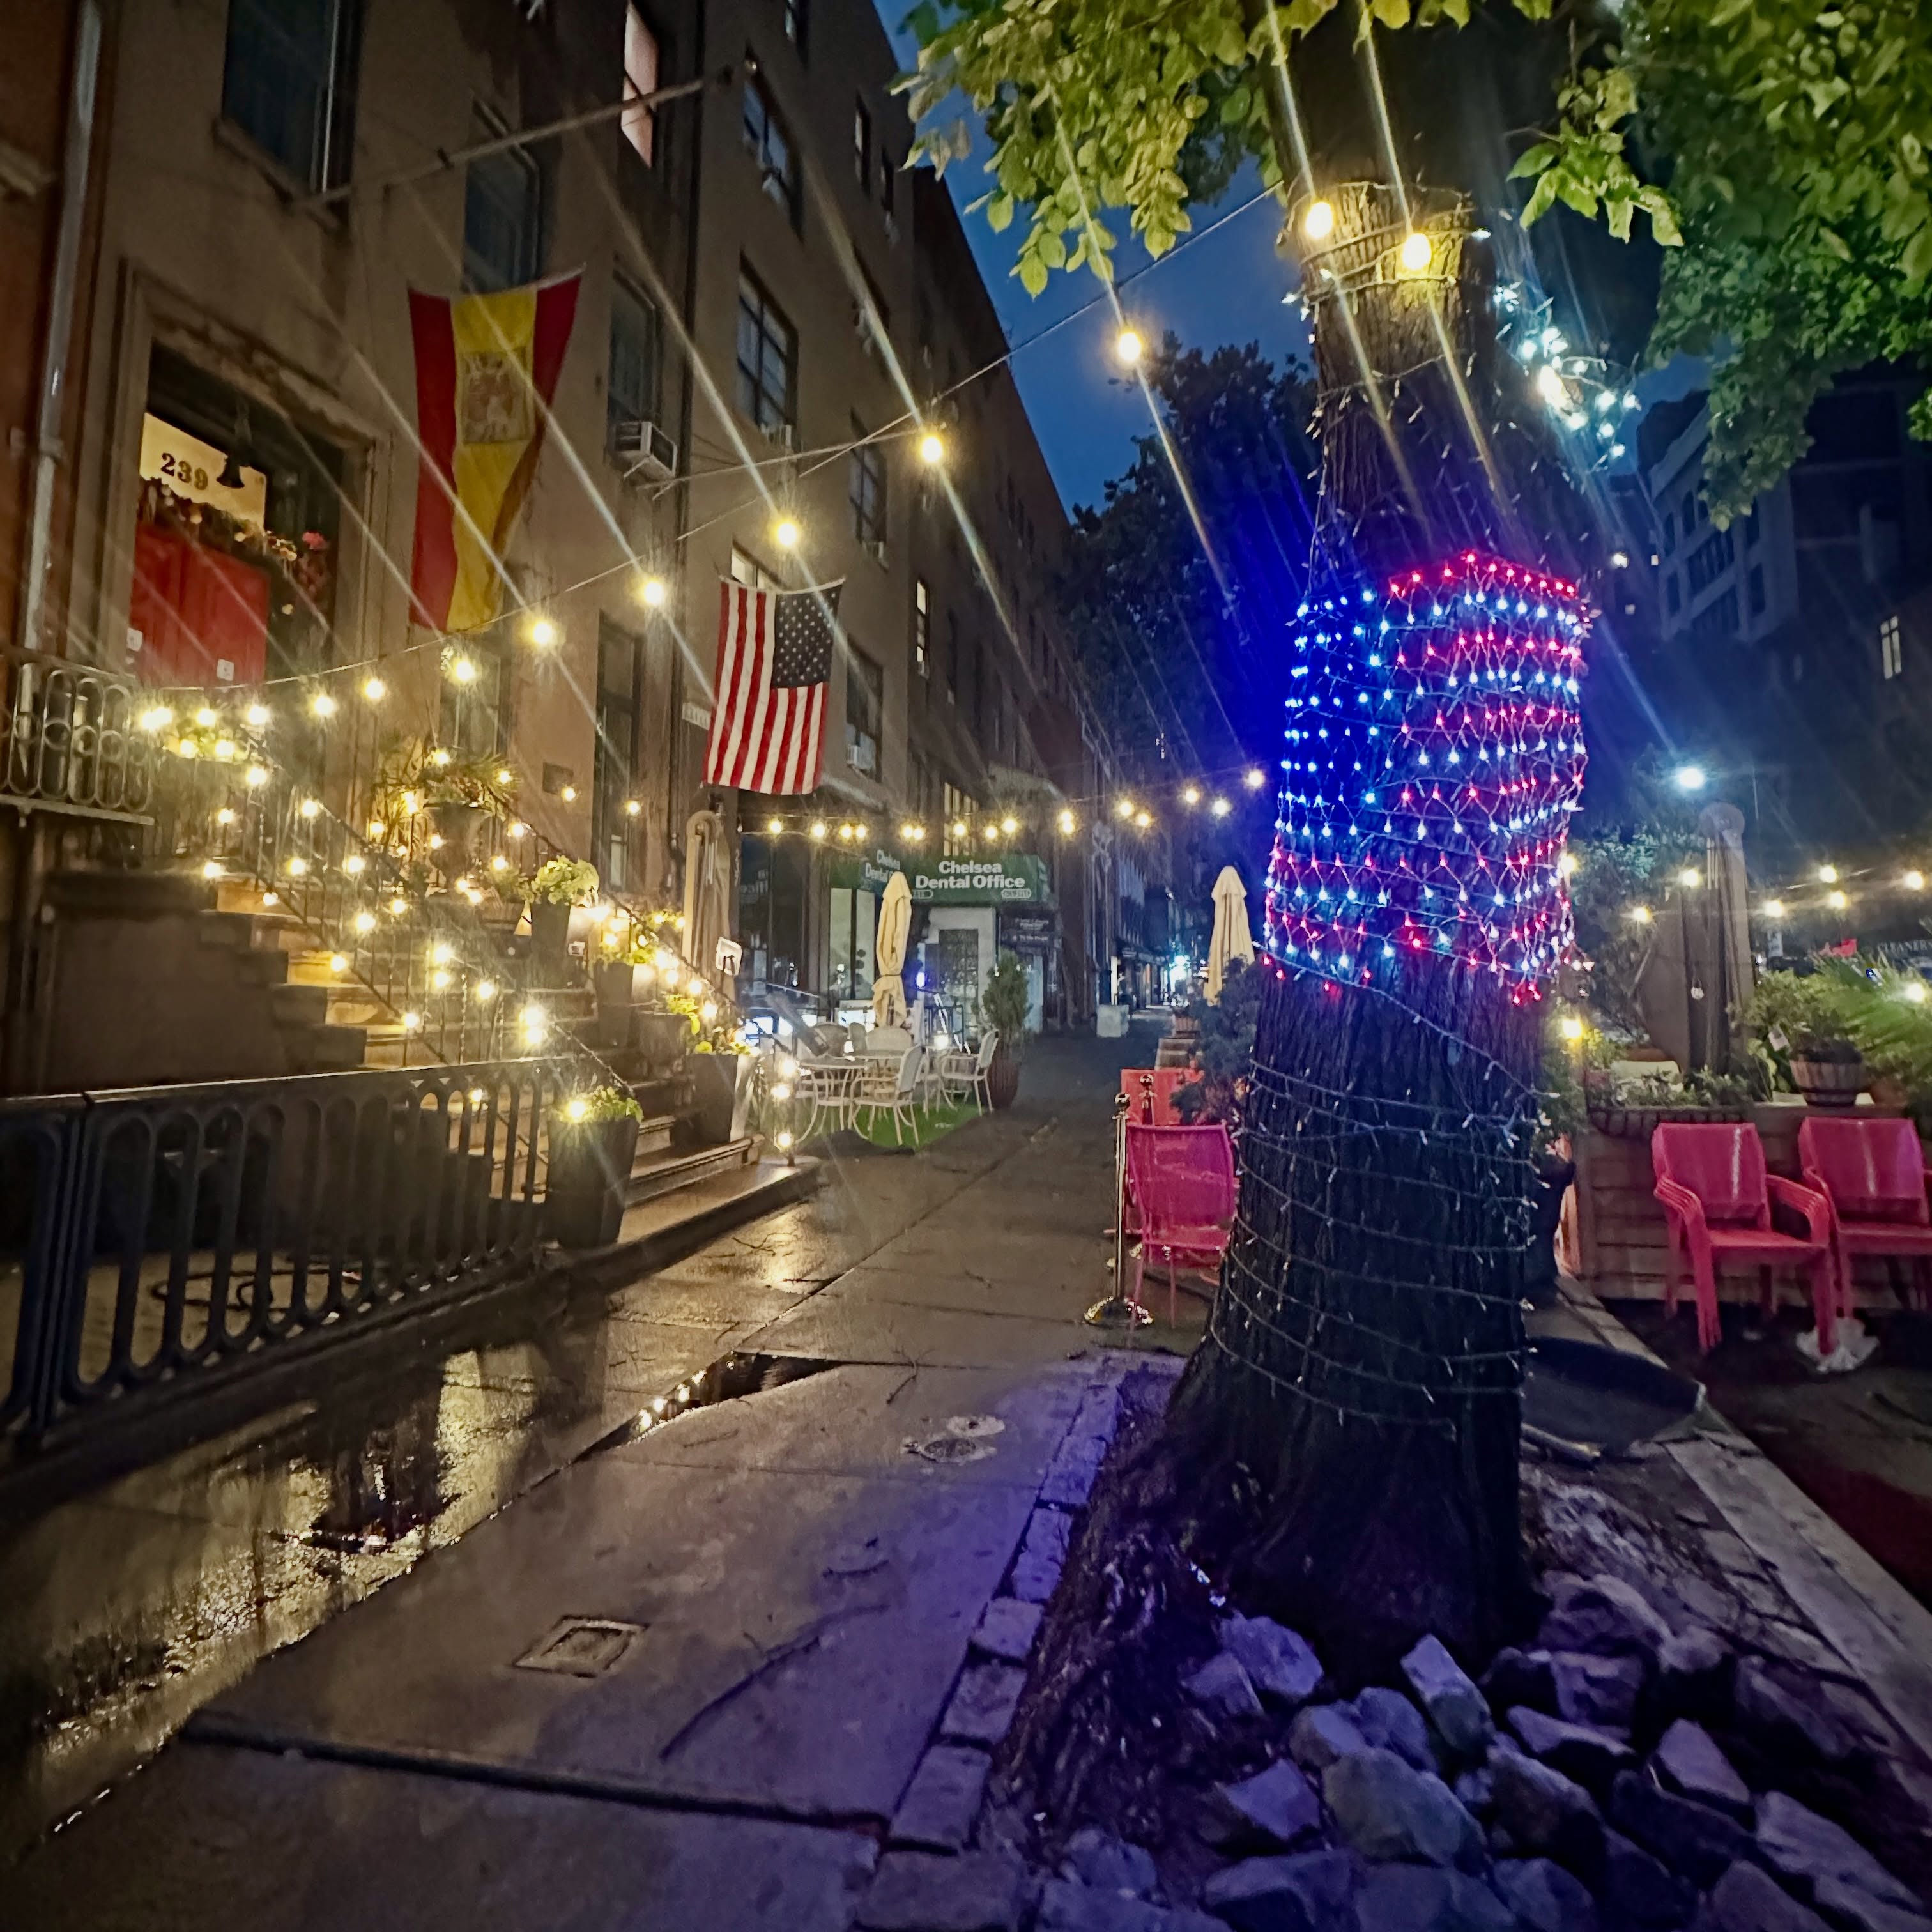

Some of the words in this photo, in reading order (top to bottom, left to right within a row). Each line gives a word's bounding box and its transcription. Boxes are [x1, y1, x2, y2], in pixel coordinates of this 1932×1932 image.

[160, 452, 209, 491] 239
[939, 861, 1002, 874] Chelsea
[915, 875, 970, 889] Dental
[972, 875, 1025, 889] Office
